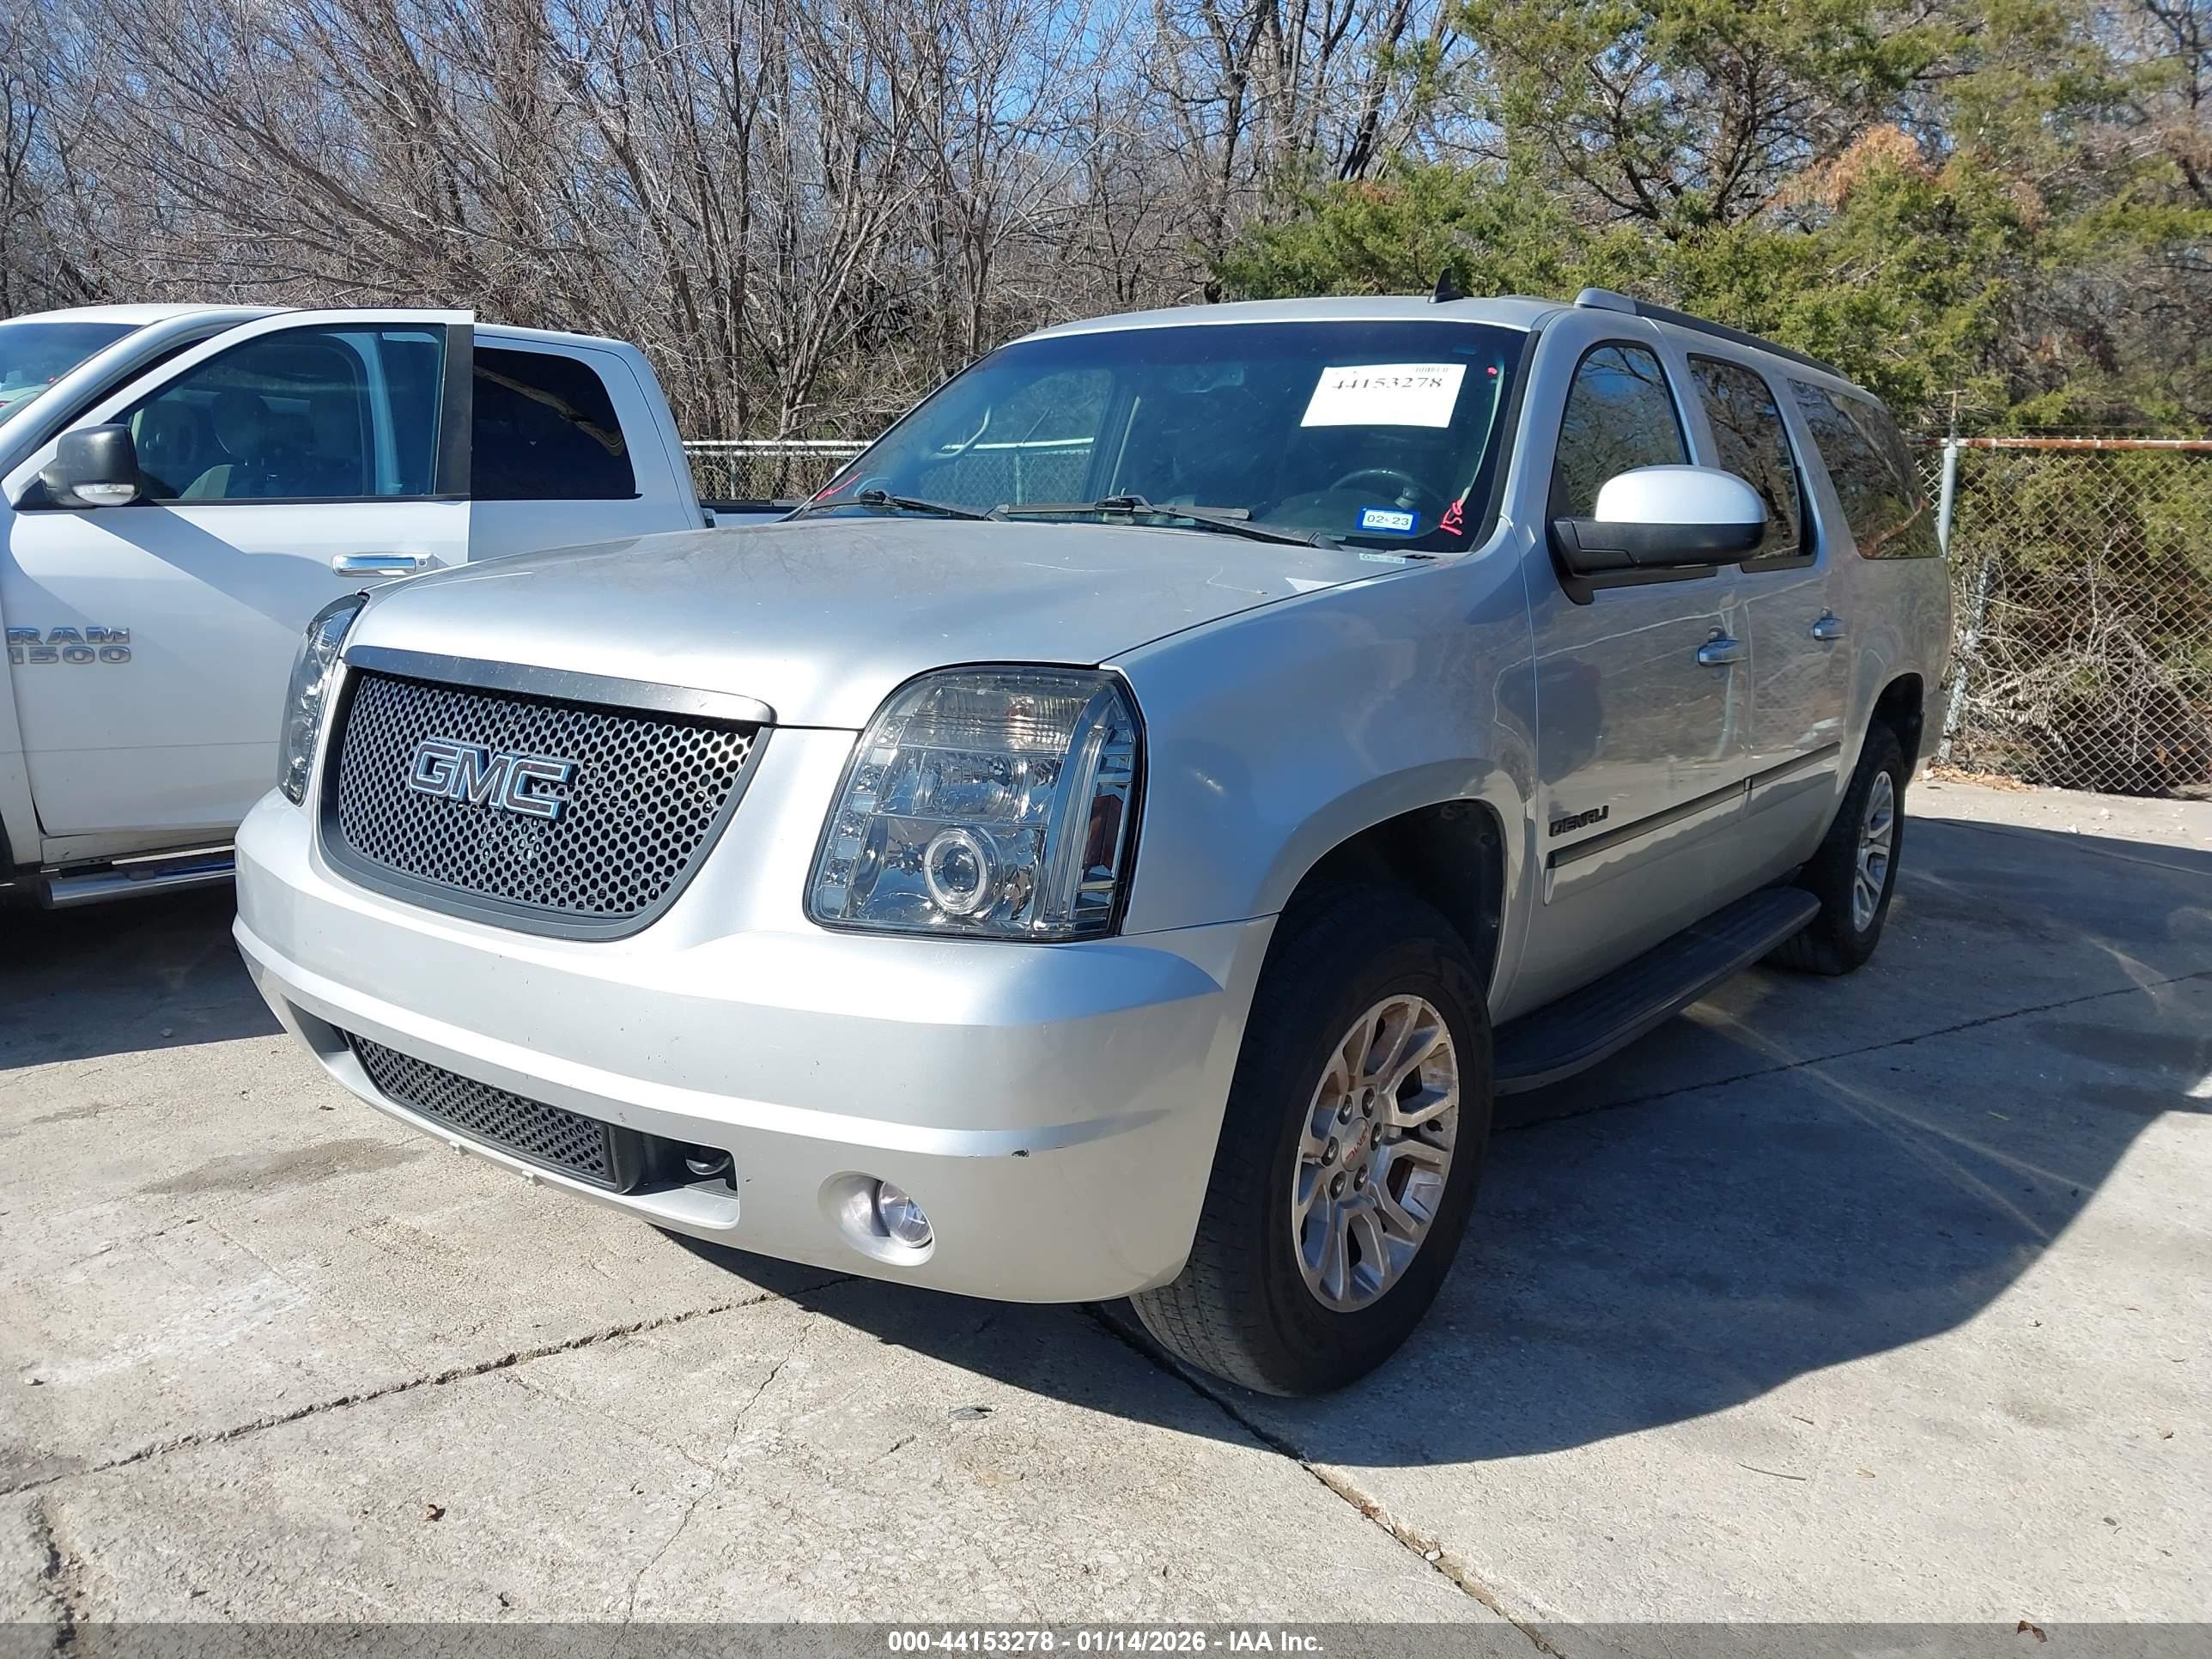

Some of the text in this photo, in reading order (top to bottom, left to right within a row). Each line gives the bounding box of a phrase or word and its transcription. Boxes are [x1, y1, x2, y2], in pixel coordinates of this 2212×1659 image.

[1332, 377, 1443, 389] 44153278
[7, 627, 131, 644] RAM
[8, 645, 131, 665] 1500
[409, 738, 577, 820] GMC
[1549, 805, 1609, 837] DENALI
